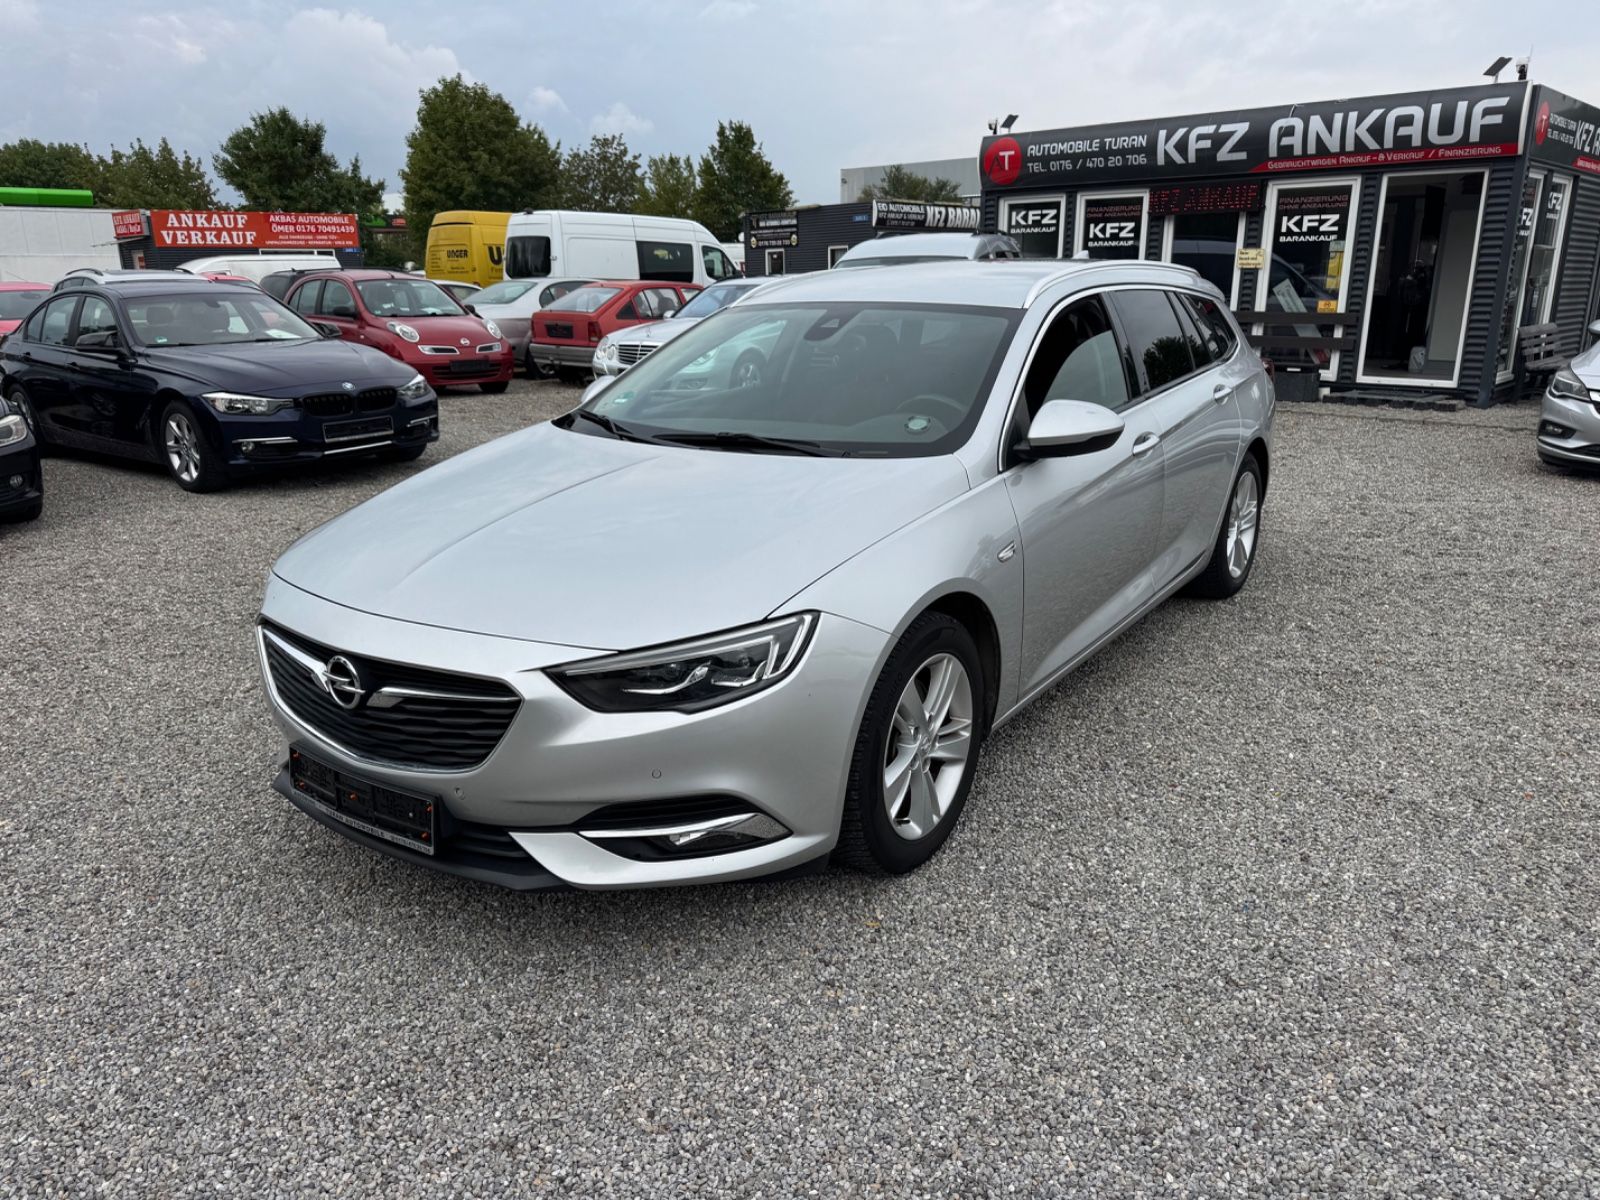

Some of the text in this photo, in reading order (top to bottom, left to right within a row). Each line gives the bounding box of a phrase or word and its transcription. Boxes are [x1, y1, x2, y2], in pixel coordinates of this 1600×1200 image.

[1156, 96, 1511, 166] KFZ ANKAUF
[1027, 134, 1147, 157] AUTOMOBILE TURAN
[1438, 145, 1502, 158] FINANZIERUNG
[1027, 162, 1047, 173] TEL.
[1050, 160, 1073, 171] 0176
[1086, 157, 1105, 168] 470
[1107, 156, 1123, 167] 20
[1125, 153, 1147, 165] 706
[1280, 195, 1349, 204] FINANZIERUNG
[166, 212, 248, 228] ANKAUF
[269, 214, 349, 224] AKBAS AUTOMOBILE
[925, 205, 946, 228] KFZ
[1010, 209, 1057, 226] KFZ
[1281, 213, 1340, 233] KFZ
[271, 223, 295, 233] ÖMER
[296, 224, 316, 233] 0176
[1010, 226, 1057, 234] BARANKAUF
[1089, 222, 1136, 239] KFZ
[160, 230, 257, 245] VERKAUF
[1279, 234, 1338, 243] BARANKAUF
